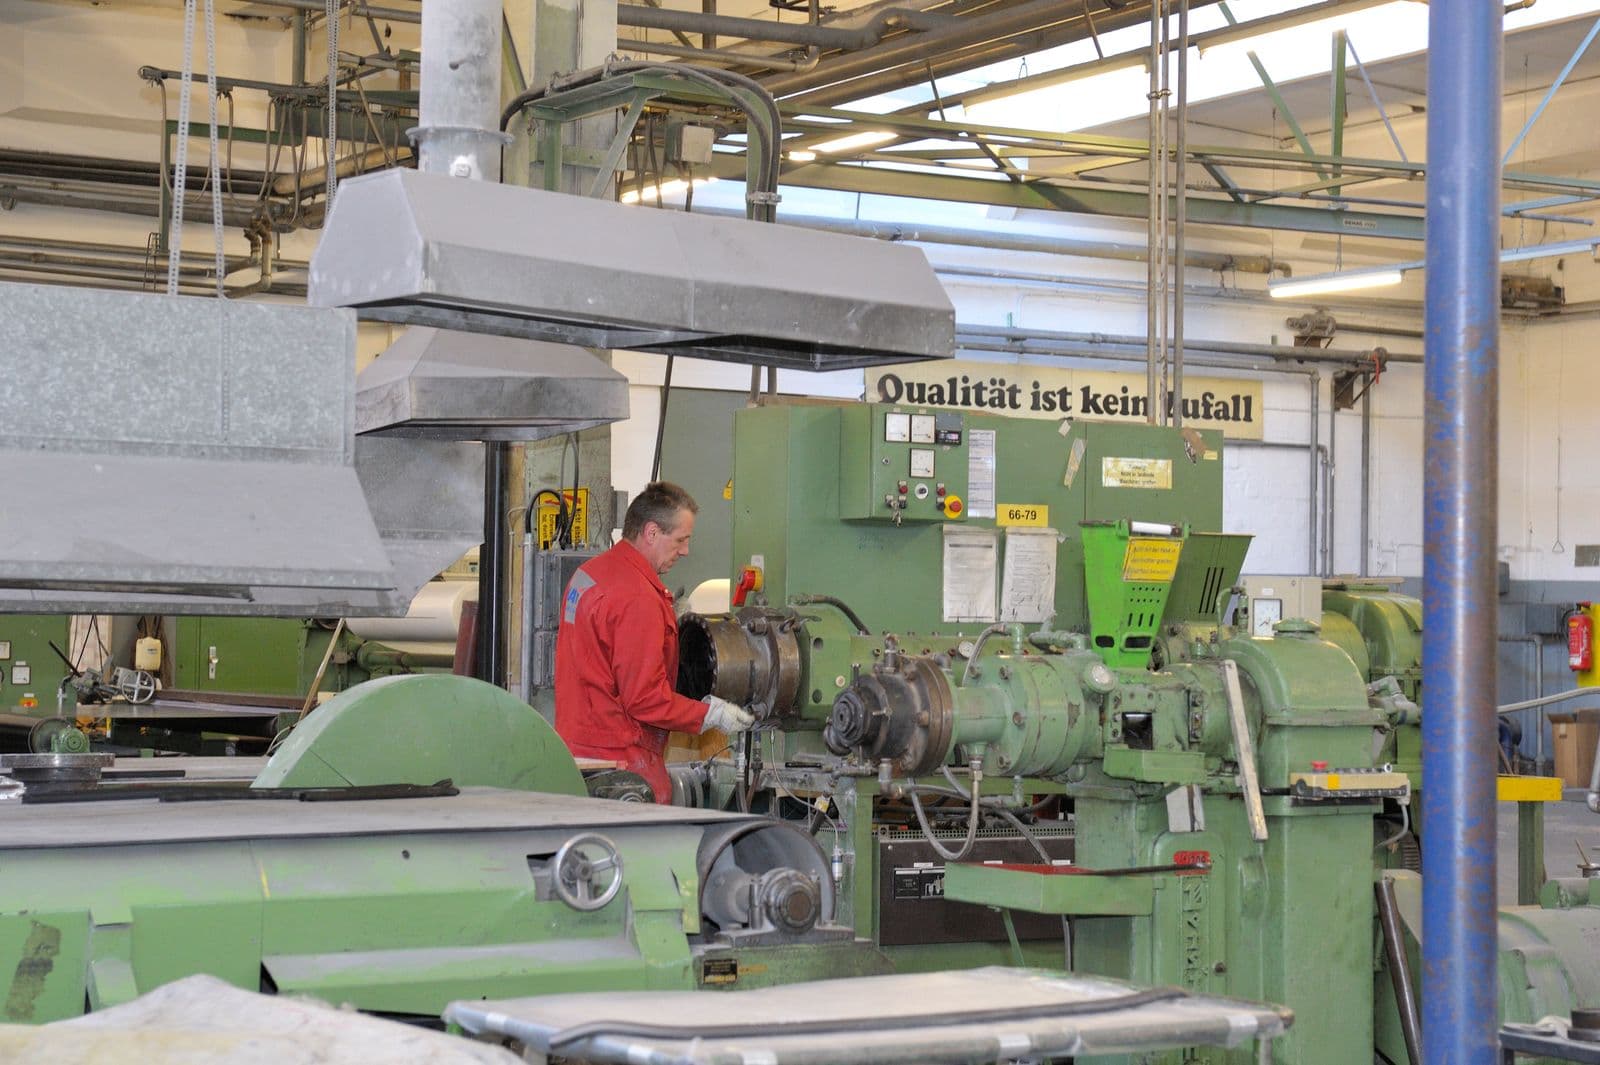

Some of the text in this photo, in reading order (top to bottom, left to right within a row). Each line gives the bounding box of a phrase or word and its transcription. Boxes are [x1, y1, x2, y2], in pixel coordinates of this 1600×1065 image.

[877, 373, 1022, 410] Qualität
[1030, 380, 1073, 413] ist
[1080, 385, 1148, 417] kein
[1008, 509, 1038, 521] 66-79
